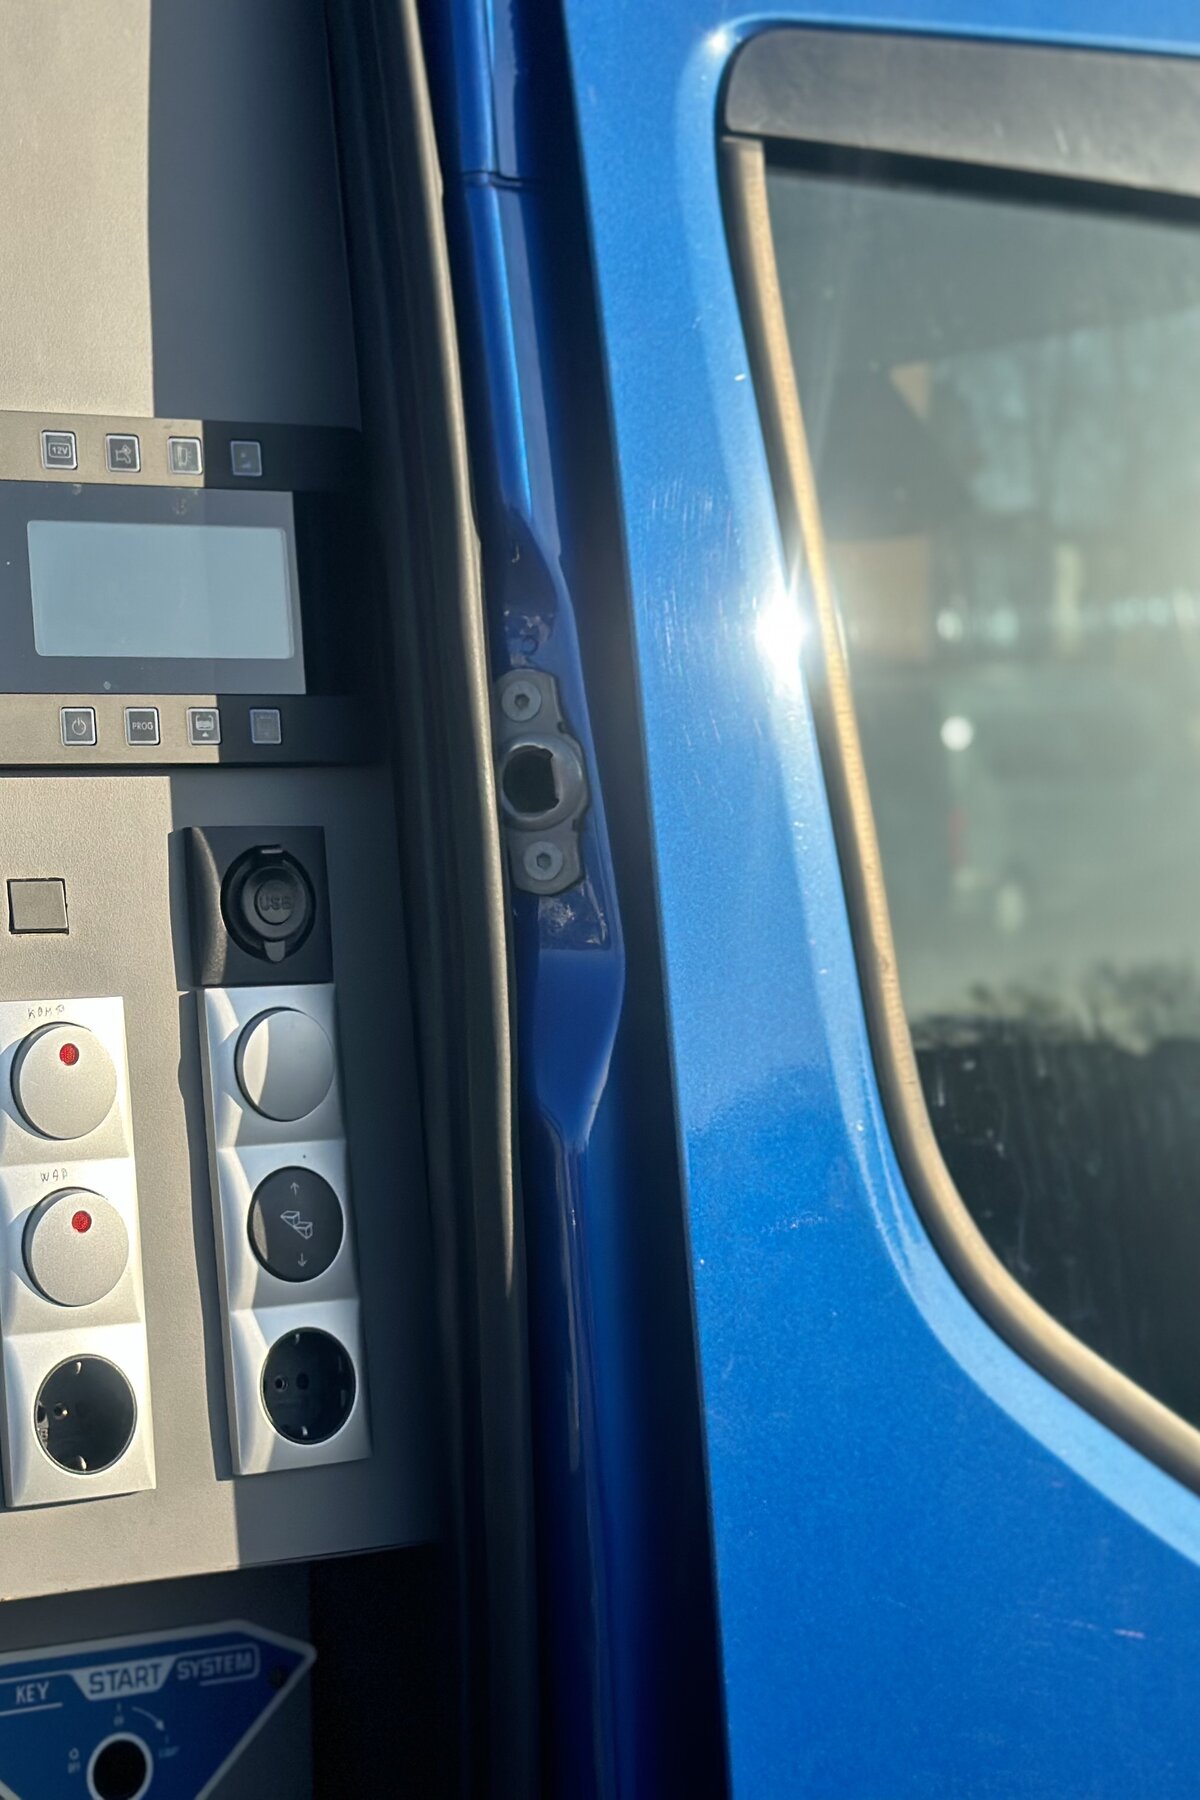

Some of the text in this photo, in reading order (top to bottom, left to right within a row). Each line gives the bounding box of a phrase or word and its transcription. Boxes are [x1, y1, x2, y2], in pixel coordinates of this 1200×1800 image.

[51, 446, 69, 456] 12V
[131, 721, 154, 731] PROG
[260, 893, 293, 912] USB
[16, 1651, 253, 1705] KEY START SYSTEM
